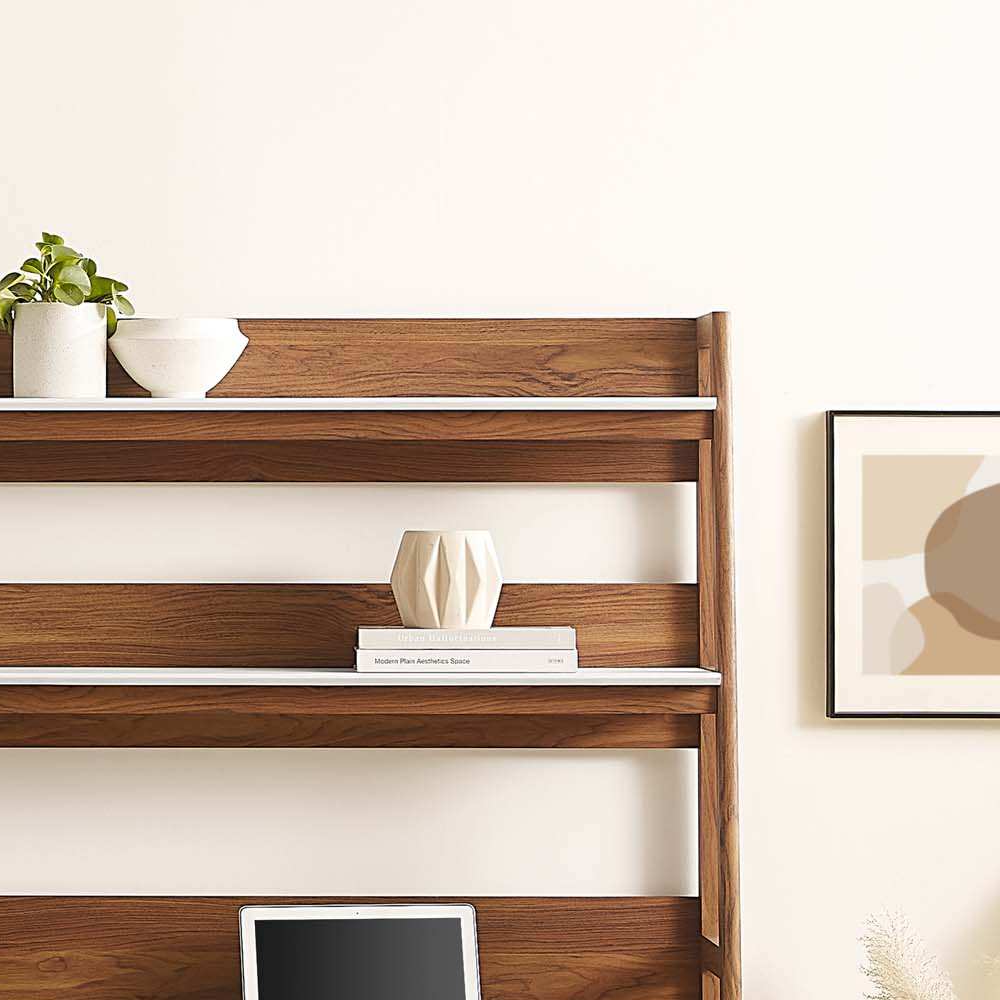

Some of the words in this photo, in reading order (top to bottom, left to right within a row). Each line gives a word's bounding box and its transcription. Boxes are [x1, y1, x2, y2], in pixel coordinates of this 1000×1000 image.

[374, 657, 399, 665] Modern
[400, 657, 416, 665] Plain
[416, 657, 450, 665] Aesthetics
[450, 657, 471, 666] Space
